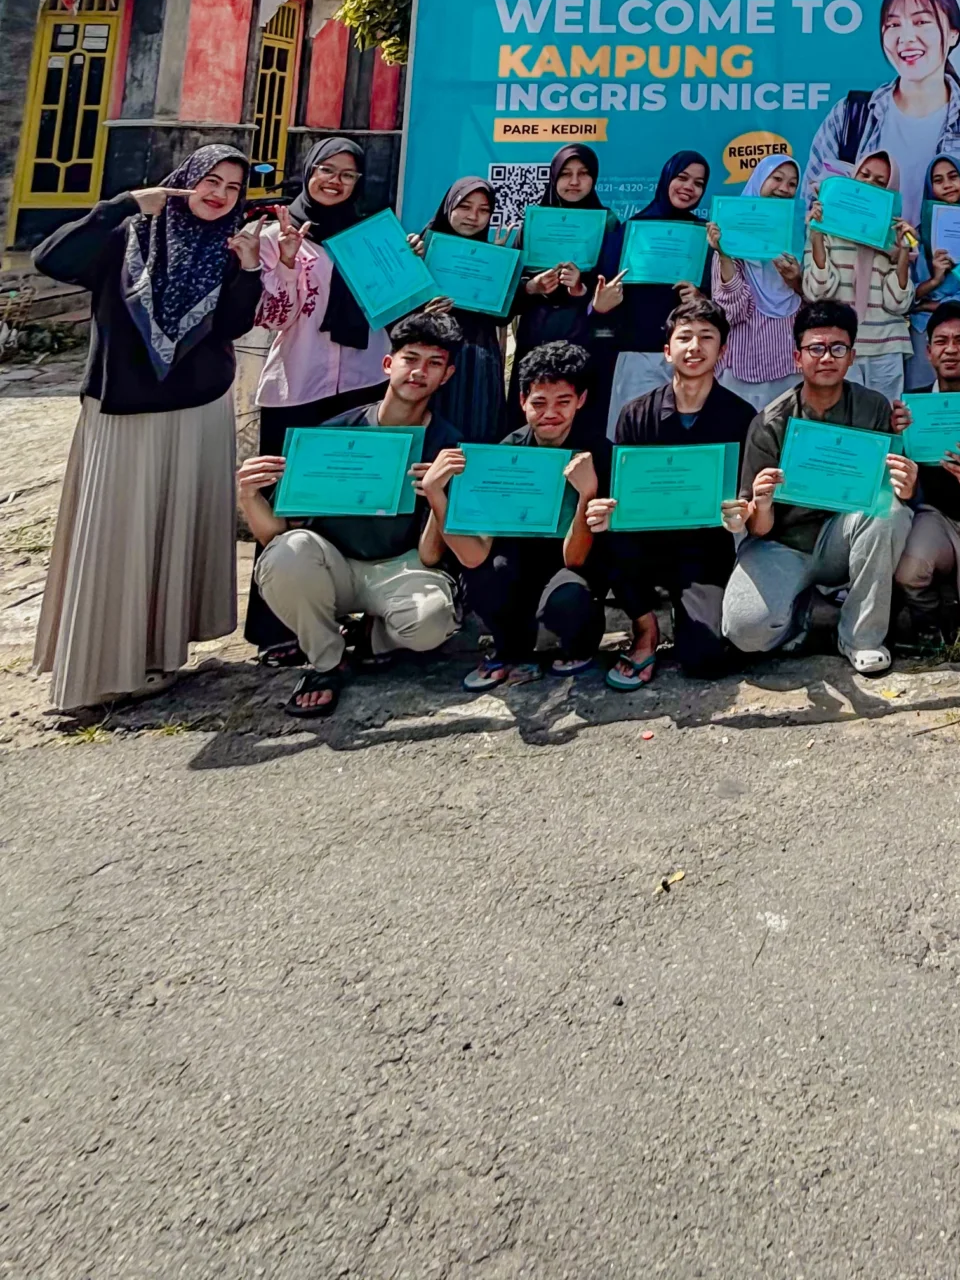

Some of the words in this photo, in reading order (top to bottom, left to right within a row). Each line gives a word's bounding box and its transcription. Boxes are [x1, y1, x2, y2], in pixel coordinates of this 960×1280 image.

[498, 44, 753, 78] KAMPUNG
[495, 83, 668, 111] INGGRIS
[680, 83, 831, 111] UNICEF
[503, 124, 539, 135] PARE
[551, 124, 597, 135] KEDIRI
[729, 143, 788, 158] REGISTER
